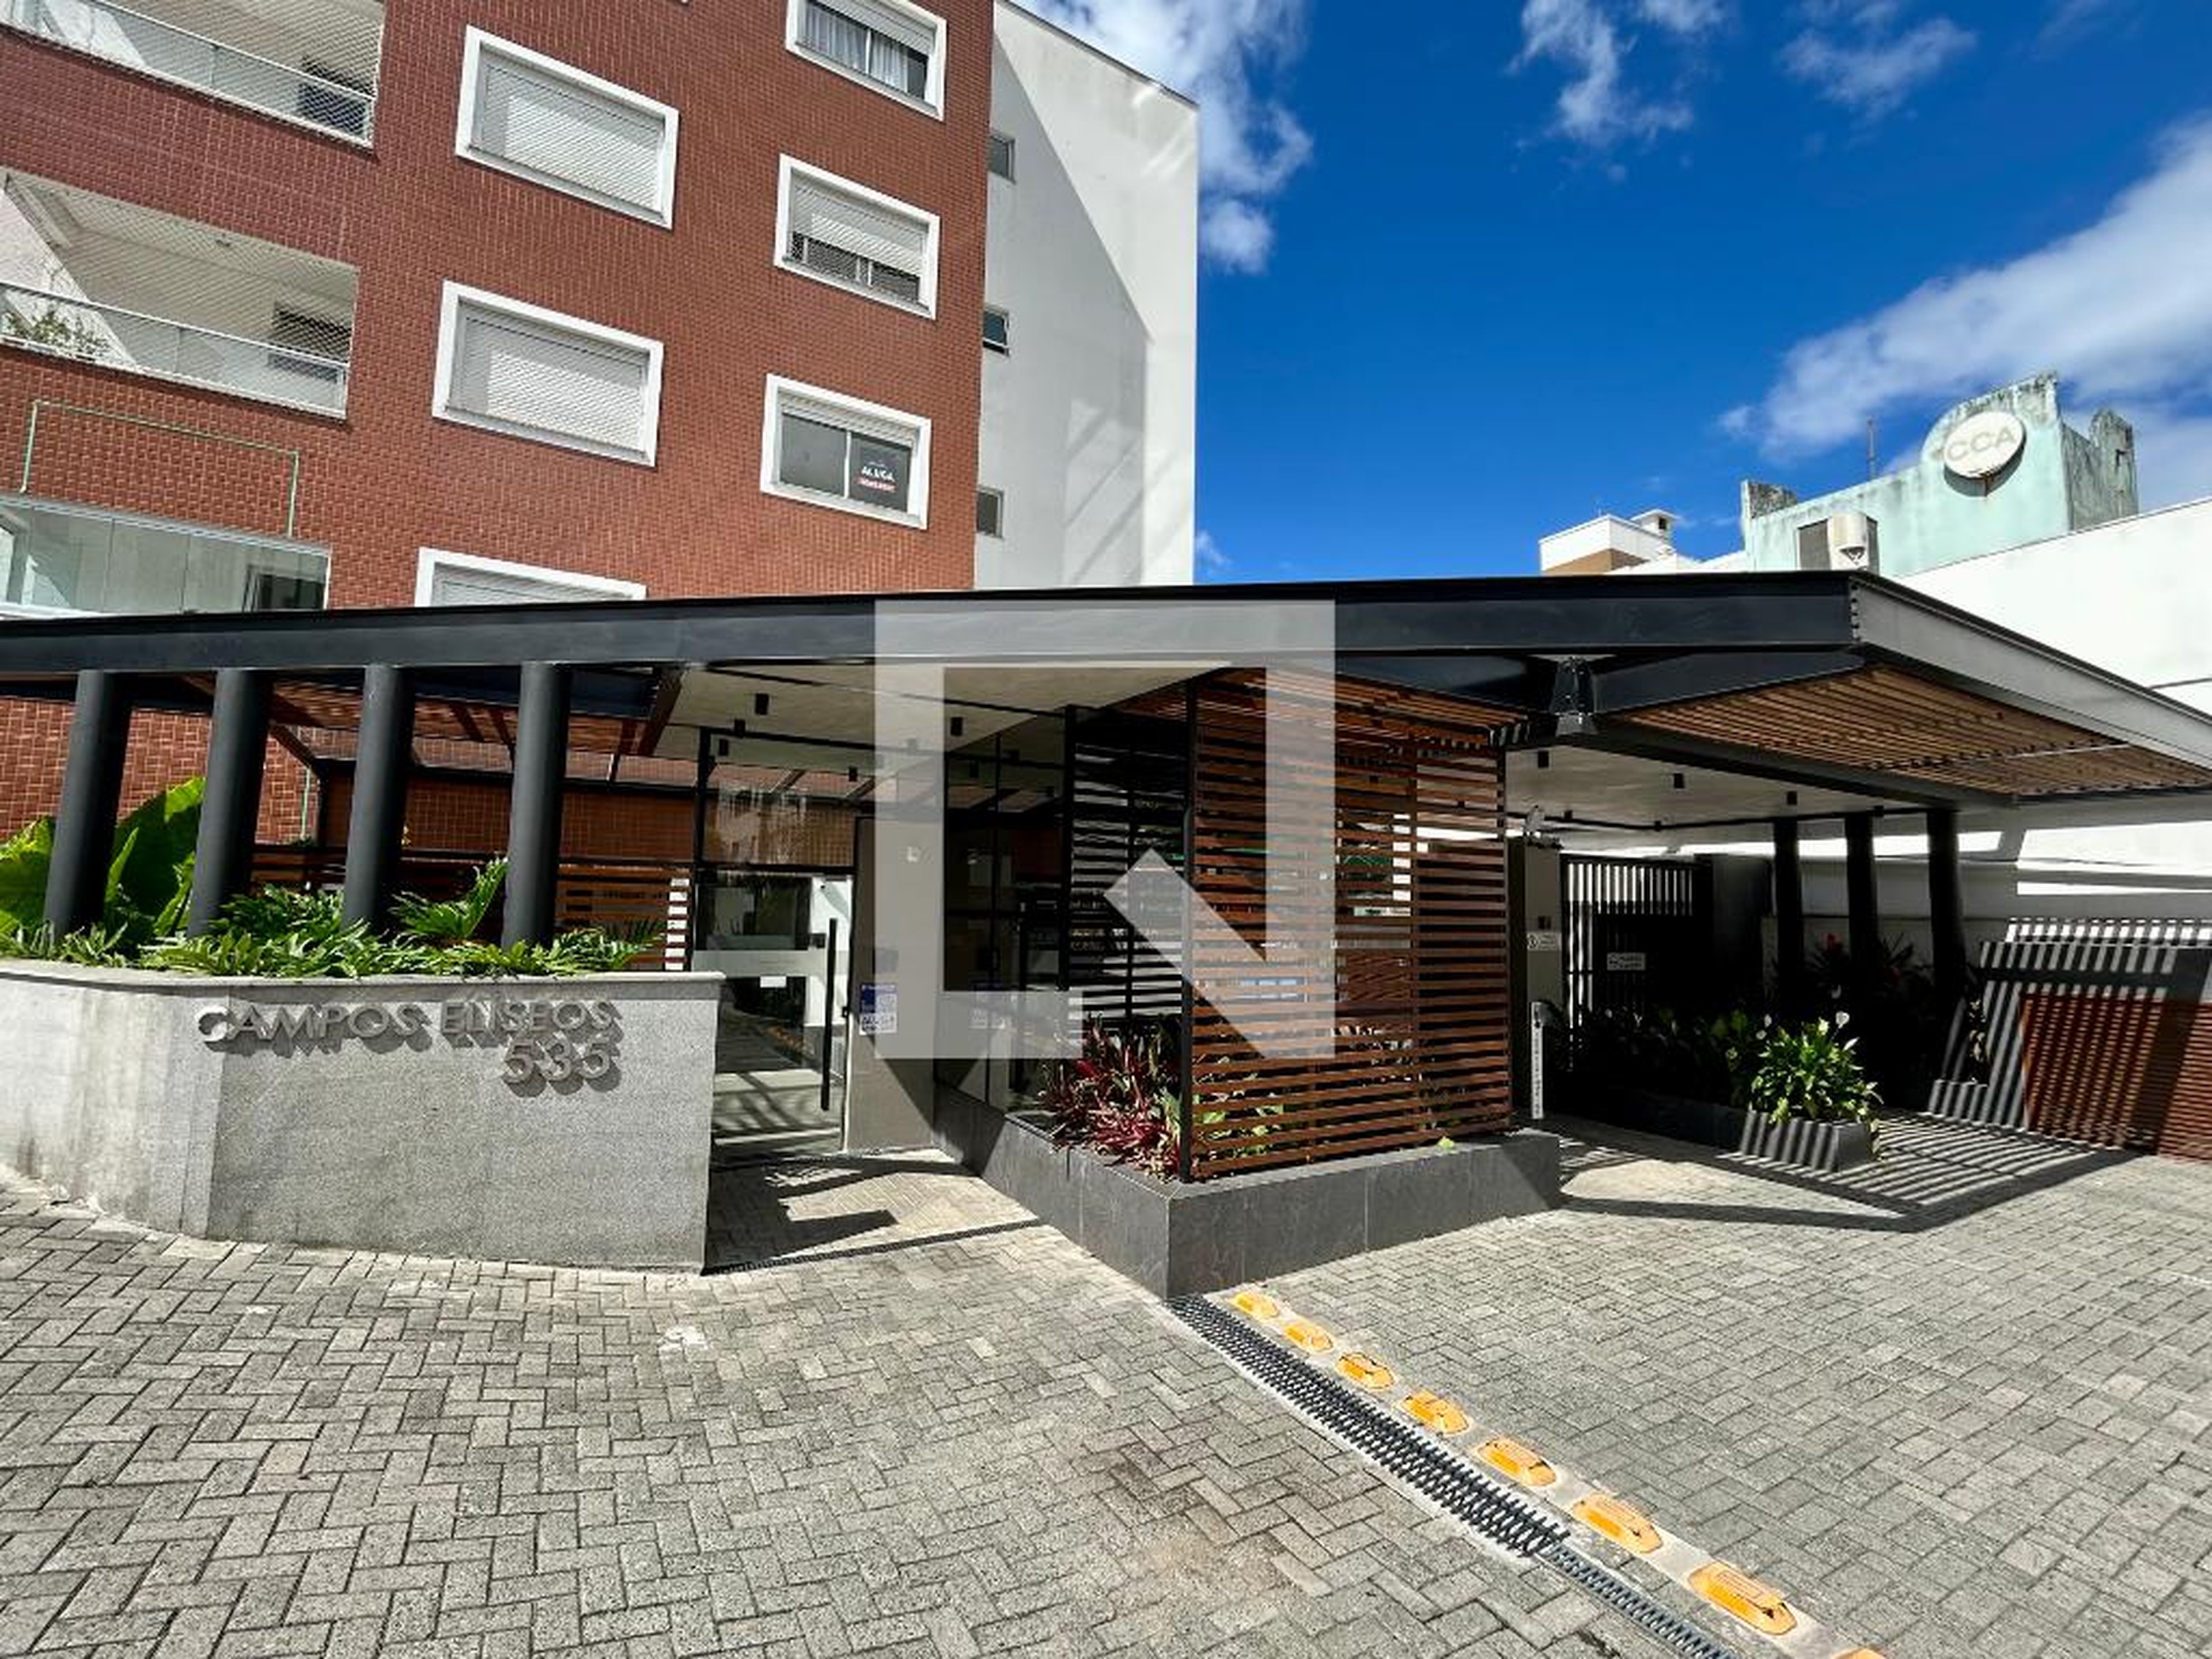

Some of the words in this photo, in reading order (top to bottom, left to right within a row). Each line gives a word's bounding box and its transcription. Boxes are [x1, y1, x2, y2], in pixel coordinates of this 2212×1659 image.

[1947, 426, 2016, 460] CCA
[195, 1005, 432, 1041] CAMPOS
[502, 1036, 615, 1084] 535
